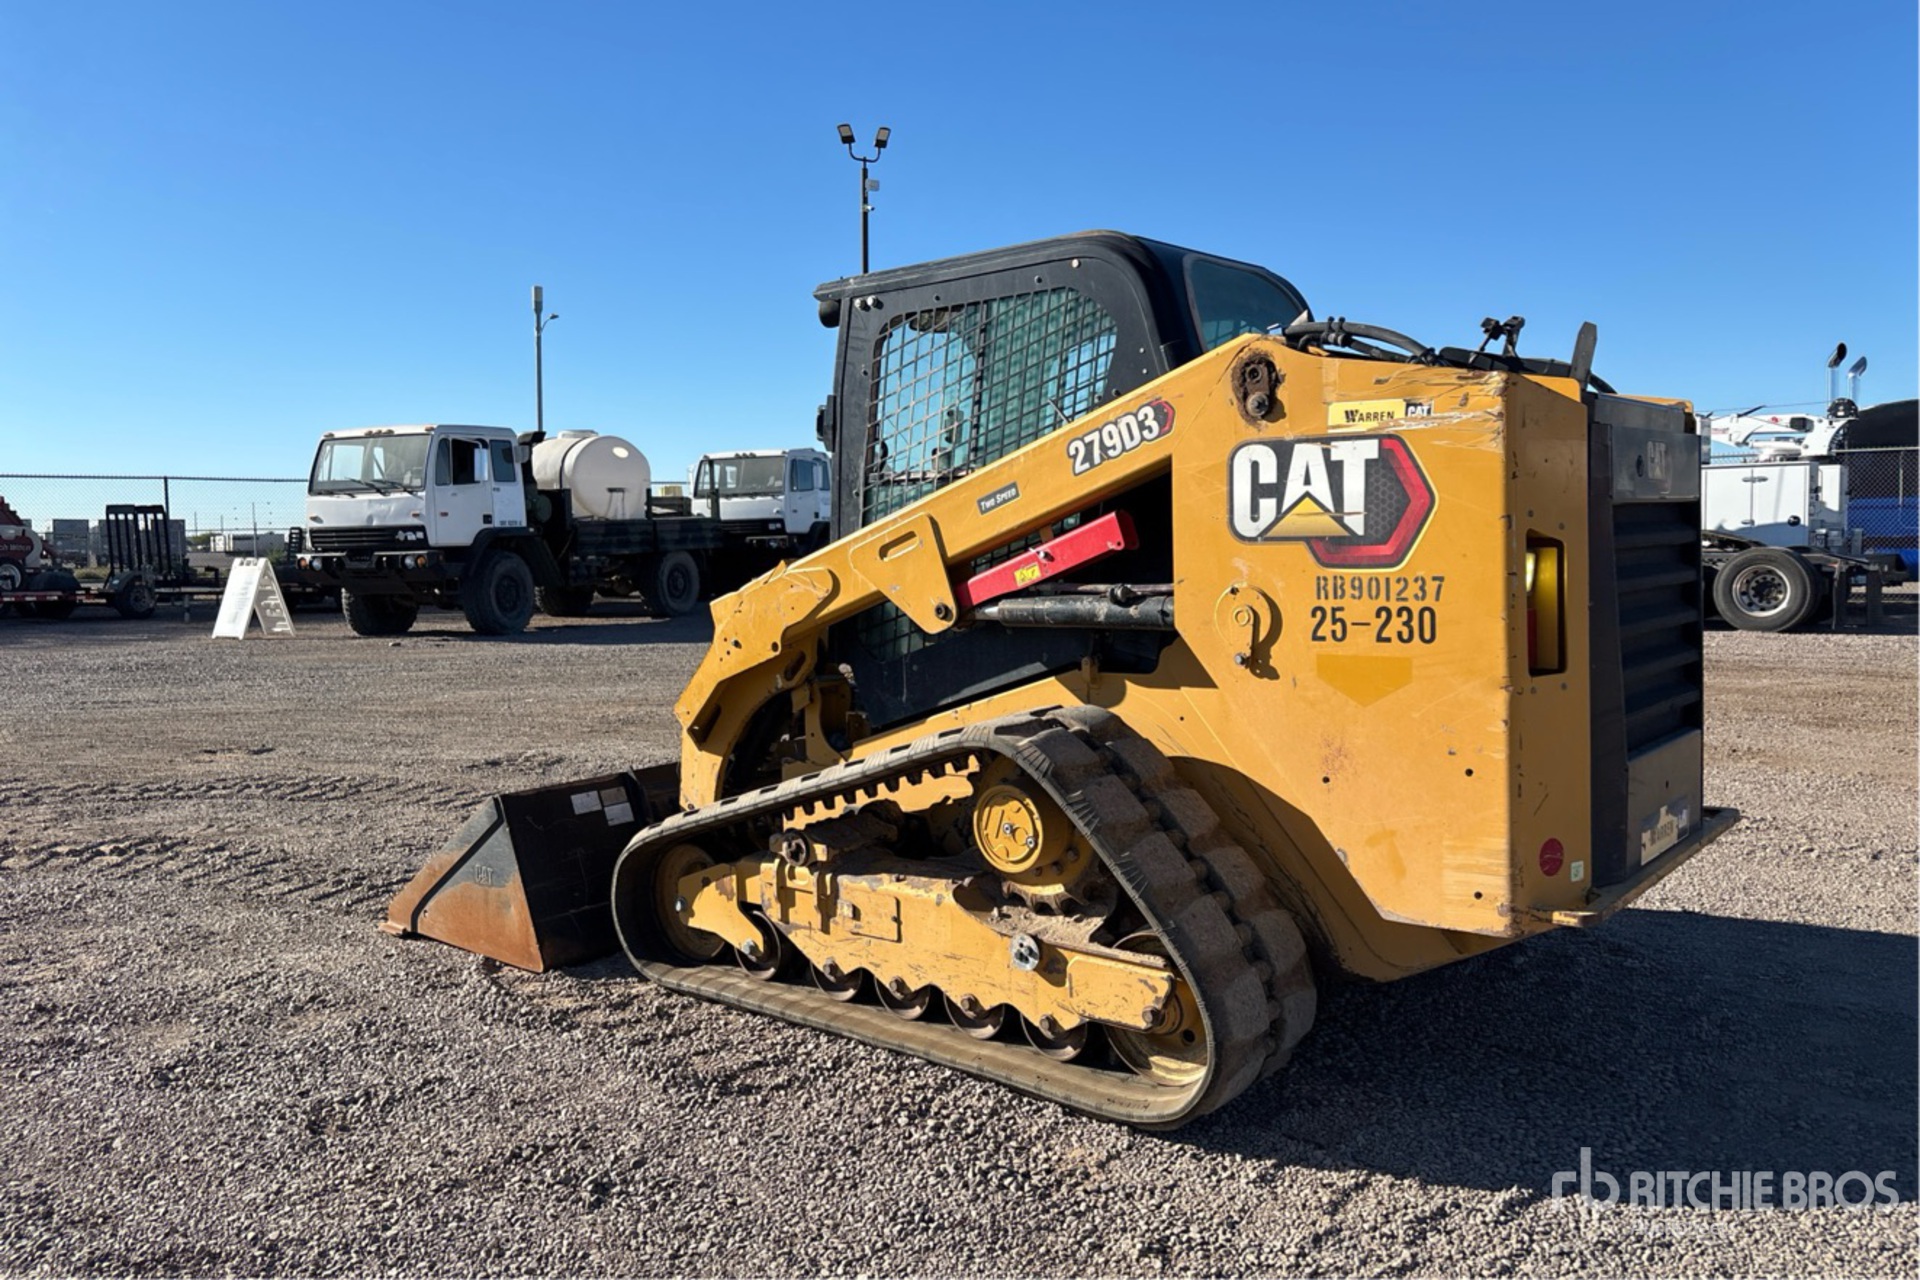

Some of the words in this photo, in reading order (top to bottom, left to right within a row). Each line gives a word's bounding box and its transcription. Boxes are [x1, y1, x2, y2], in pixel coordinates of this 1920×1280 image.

[1344, 409, 1395, 423] WARREN
[1406, 404, 1431, 418] CAT
[1068, 405, 1159, 475] 279D3
[1647, 441, 1666, 479] CAT
[1233, 438, 1379, 538] CAT
[1316, 575, 1445, 602] RB901237
[1311, 605, 1437, 644] 25-230
[475, 863, 494, 886] CAT
